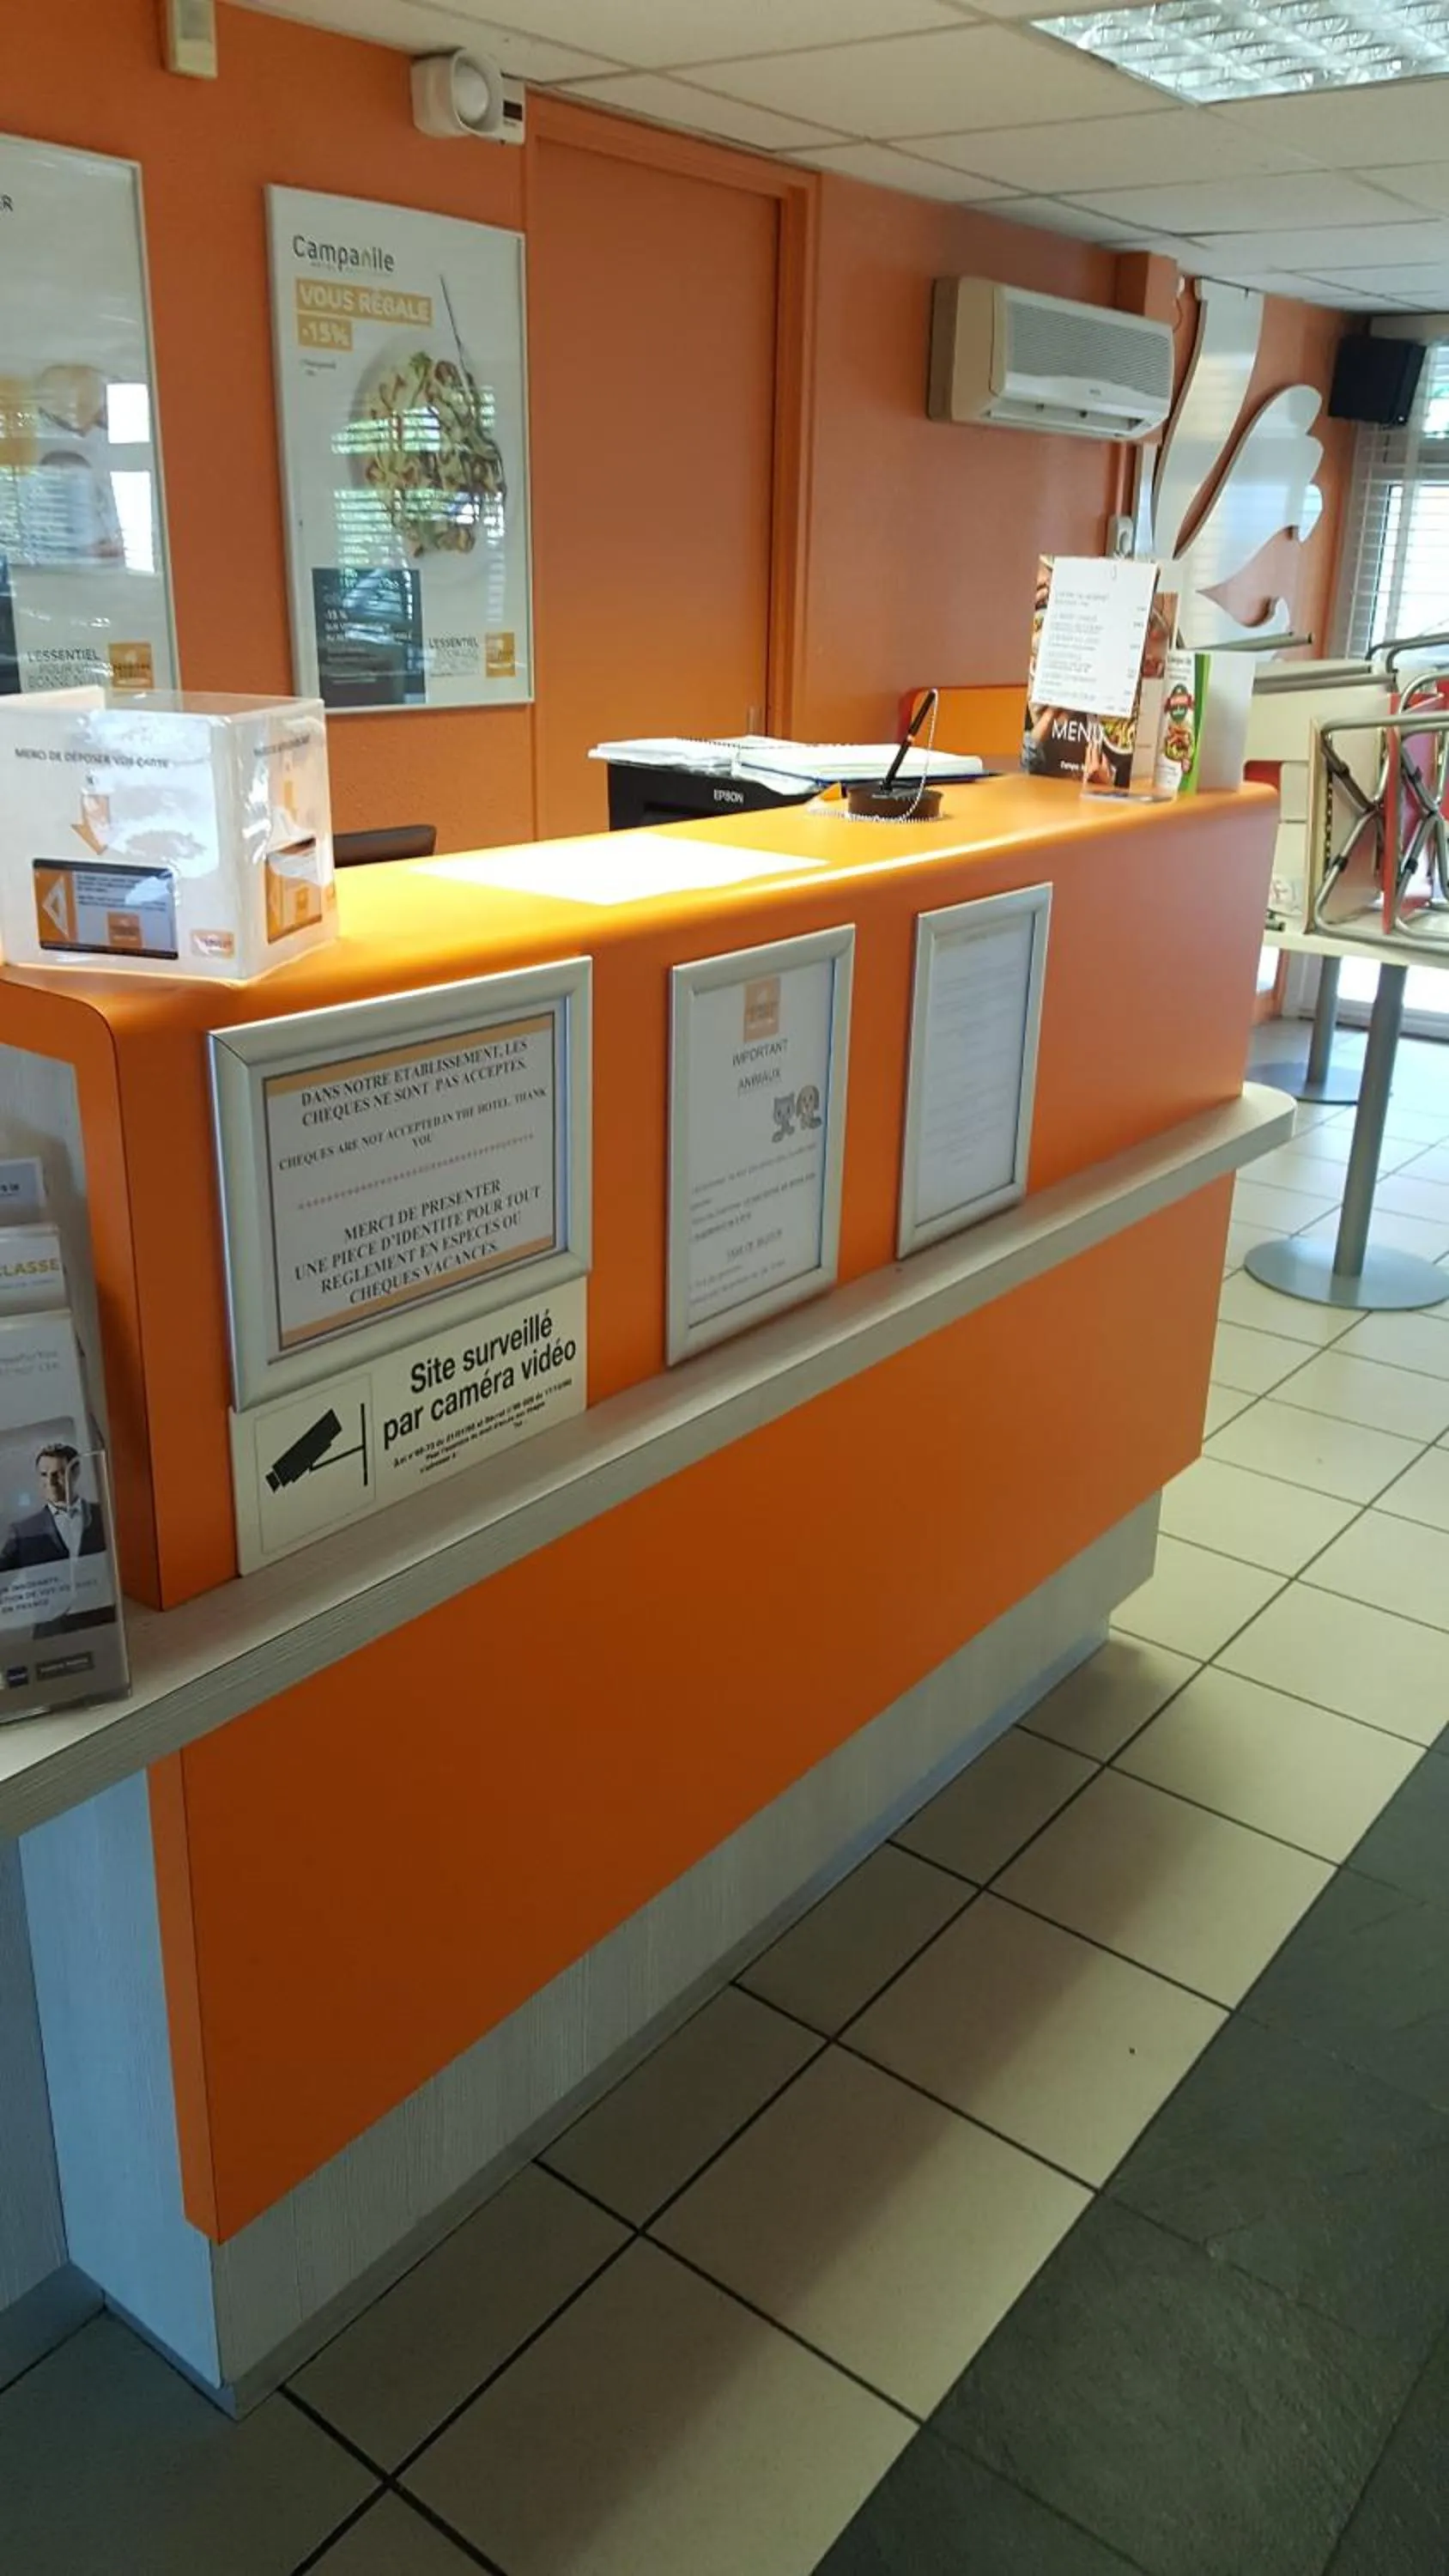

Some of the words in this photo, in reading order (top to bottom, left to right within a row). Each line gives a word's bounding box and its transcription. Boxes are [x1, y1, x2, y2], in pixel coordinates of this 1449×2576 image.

[293, 234, 395, 272] Campanile
[300, 284, 354, 312] VOUS
[1052, 720, 1103, 744] MENU
[713, 788, 744, 805] EPSON
[301, 1085, 341, 1106] DANS
[343, 1072, 389, 1096] NOTRE
[506, 1040, 528, 1055] LES
[302, 1098, 370, 1127] CHEQUES
[373, 1093, 390, 1108] NE
[394, 1081, 428, 1102] SONT
[435, 1074, 459, 1091] PAS
[279, 1147, 334, 1170] CHEQUES
[339, 1139, 358, 1153] ARE
[362, 1133, 384, 1145] NOT
[514, 1087, 548, 1103] THANK
[412, 1133, 432, 1148] YOU
[295, 1256, 327, 1281] UNE
[332, 1242, 376, 1268] PIECE
[466, 1199, 502, 1222] POUR
[507, 1185, 541, 1206] TOUT
[344, 1213, 394, 1240] MERCI
[398, 1206, 416, 1224] DE
[421, 1179, 500, 1217] PRESENTER
[321, 1249, 415, 1293] REGLEMENT
[421, 1241, 439, 1259] EN
[443, 1222, 500, 1250] ESPECES
[502, 1209, 521, 1229] OU
[349, 1268, 420, 1303] CHEQUES
[410, 1358, 456, 1394] Site
[463, 1309, 553, 1372] surveillé
[384, 1406, 424, 1450] par
[430, 1367, 514, 1421] caméra
[521, 1338, 576, 1380] vidéo
